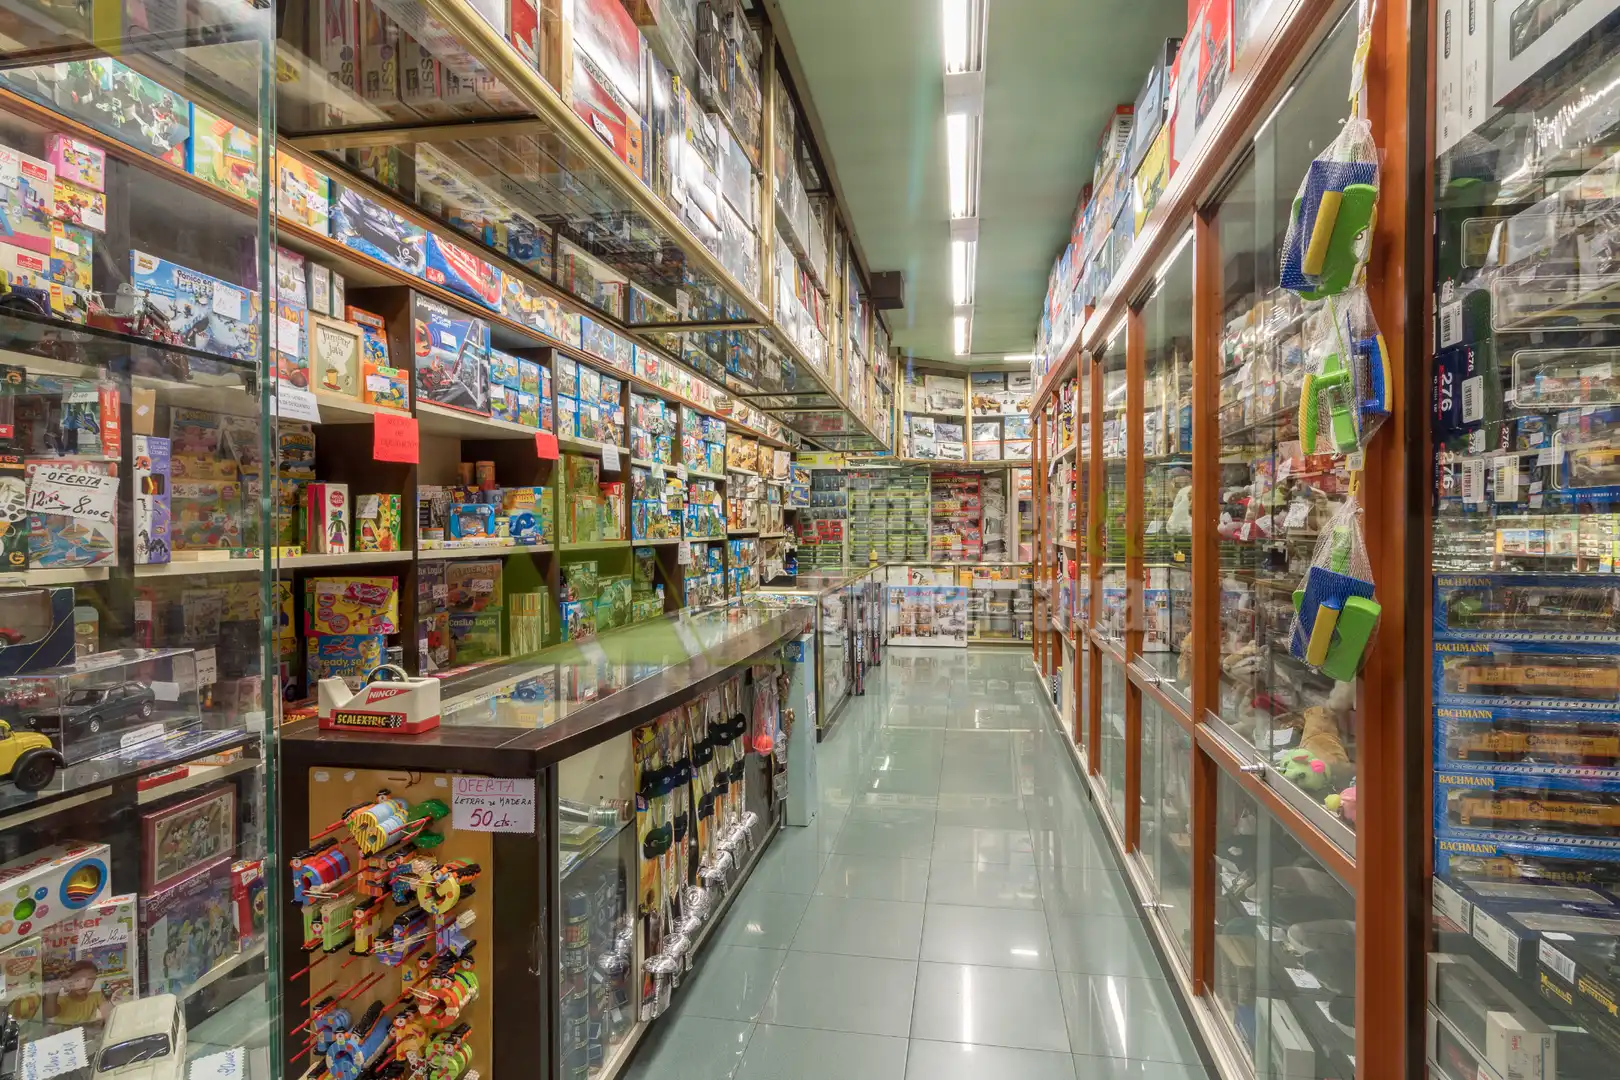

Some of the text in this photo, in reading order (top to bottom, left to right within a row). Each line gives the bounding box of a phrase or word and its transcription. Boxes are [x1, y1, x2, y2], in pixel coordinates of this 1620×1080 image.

[1467, 350, 1475, 373] 276
[1441, 372, 1453, 413] 276
[1502, 426, 1510, 449] 276
[1443, 450, 1454, 489] 276
[1437, 577, 1492, 587] BACHMANN
[1435, 643, 1490, 653] BACHMANN
[369, 688, 397, 699] NINCO
[336, 713, 387, 727] SCALEXTRIC
[1437, 709, 1493, 719] BACHMANN
[458, 778, 515, 793] OFERTA
[1439, 775, 1496, 787] BACHMANN
[454, 796, 485, 805] LETRAS
[470, 808, 494, 828] 50
[1439, 842, 1497, 855] BACHMANN
